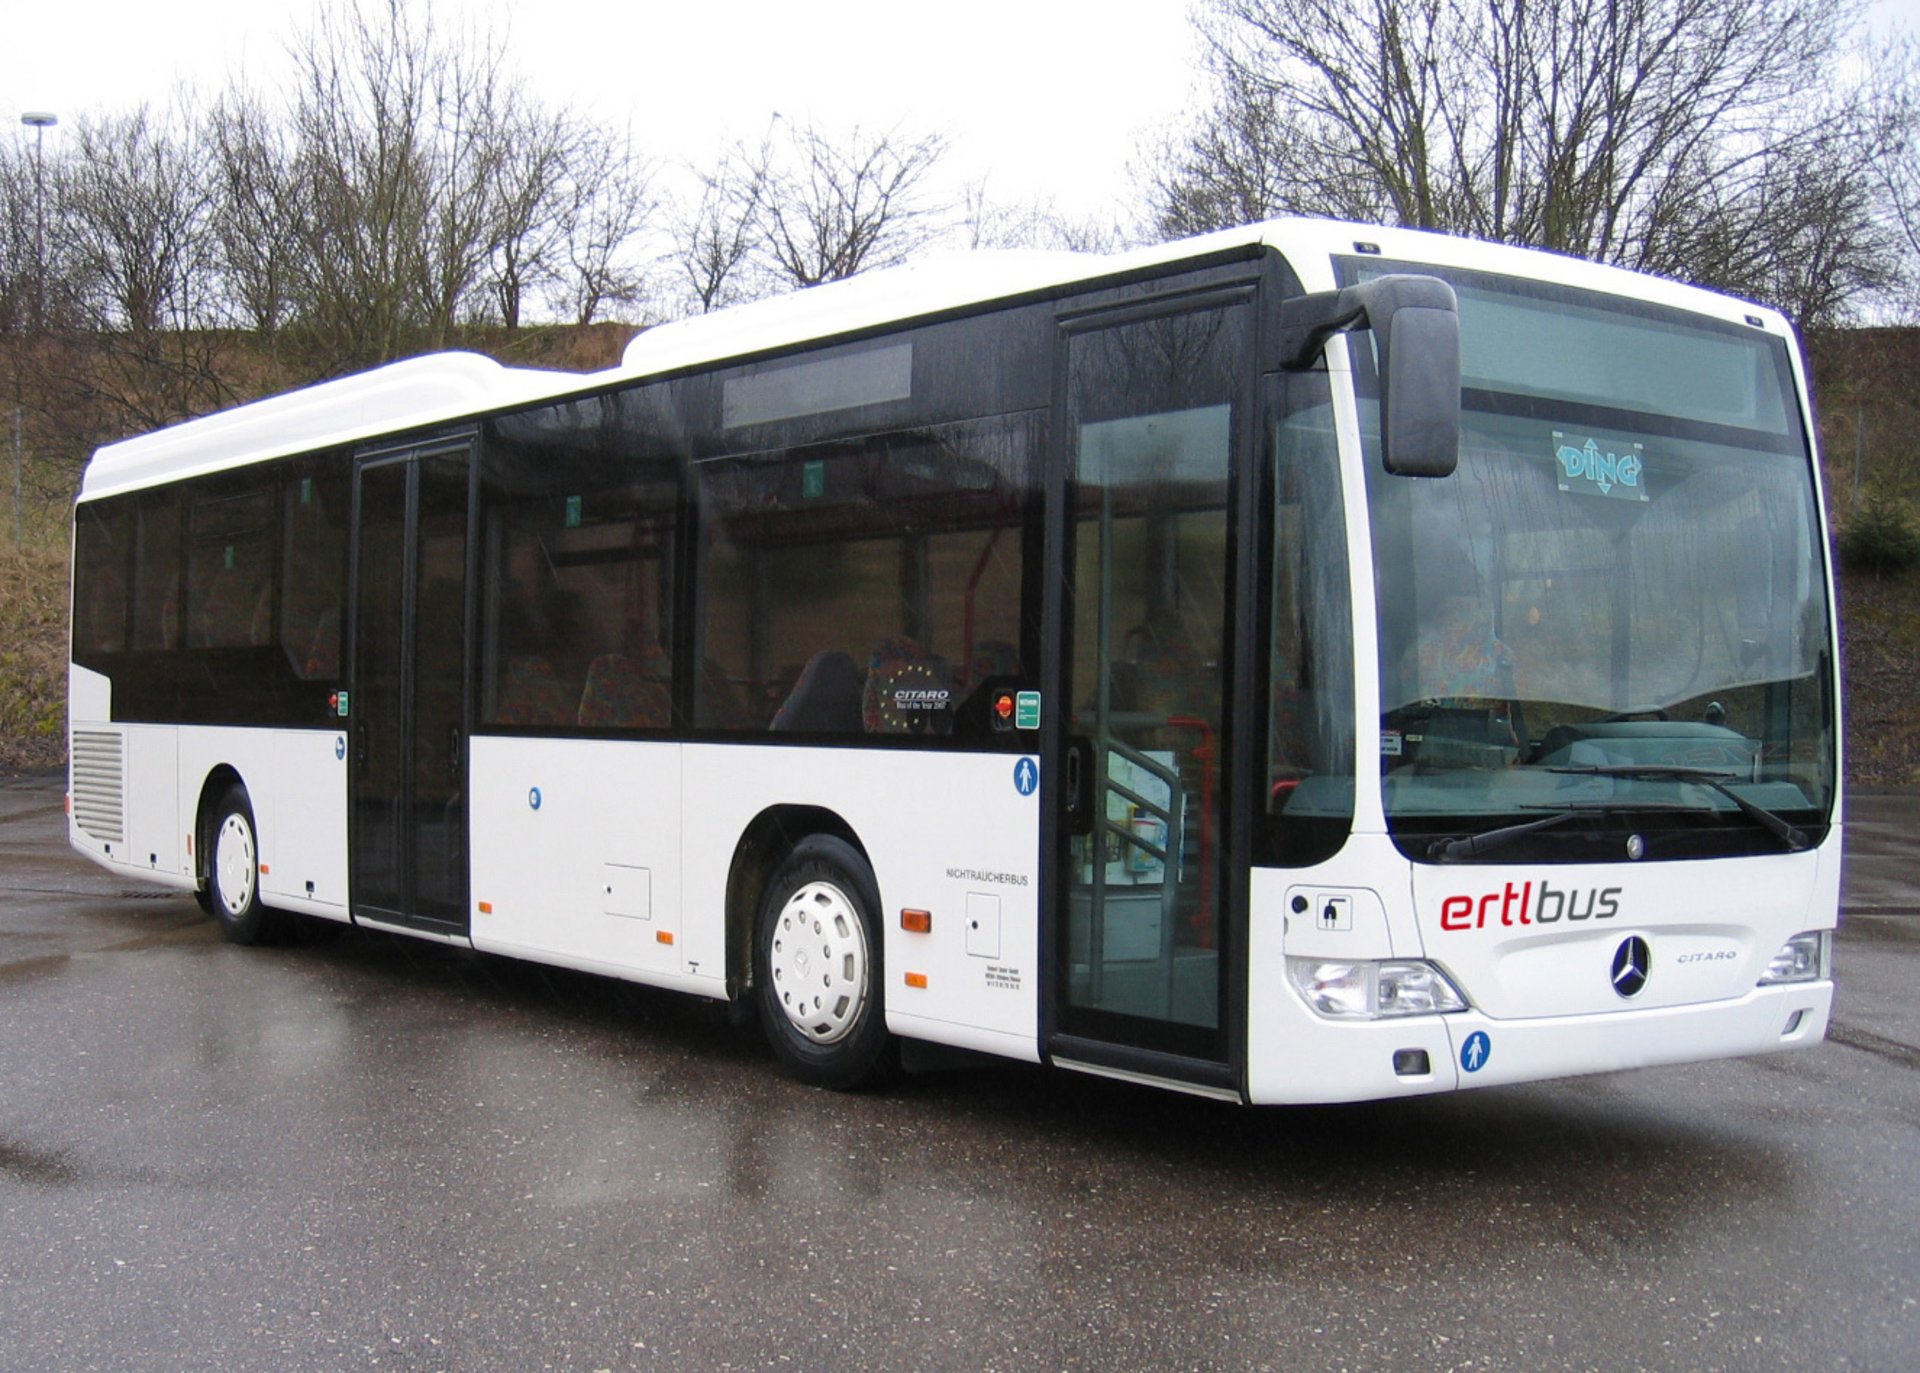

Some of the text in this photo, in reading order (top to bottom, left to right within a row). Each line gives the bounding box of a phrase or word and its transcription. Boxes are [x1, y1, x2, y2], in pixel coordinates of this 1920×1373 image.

[1556, 445, 1642, 487] DING
[895, 690, 949, 700] CITARO
[945, 868, 1029, 887] NICHTRAUCHERBUS
[1440, 880, 1623, 931] ertlbus
[1677, 950, 1737, 964] CITARO
